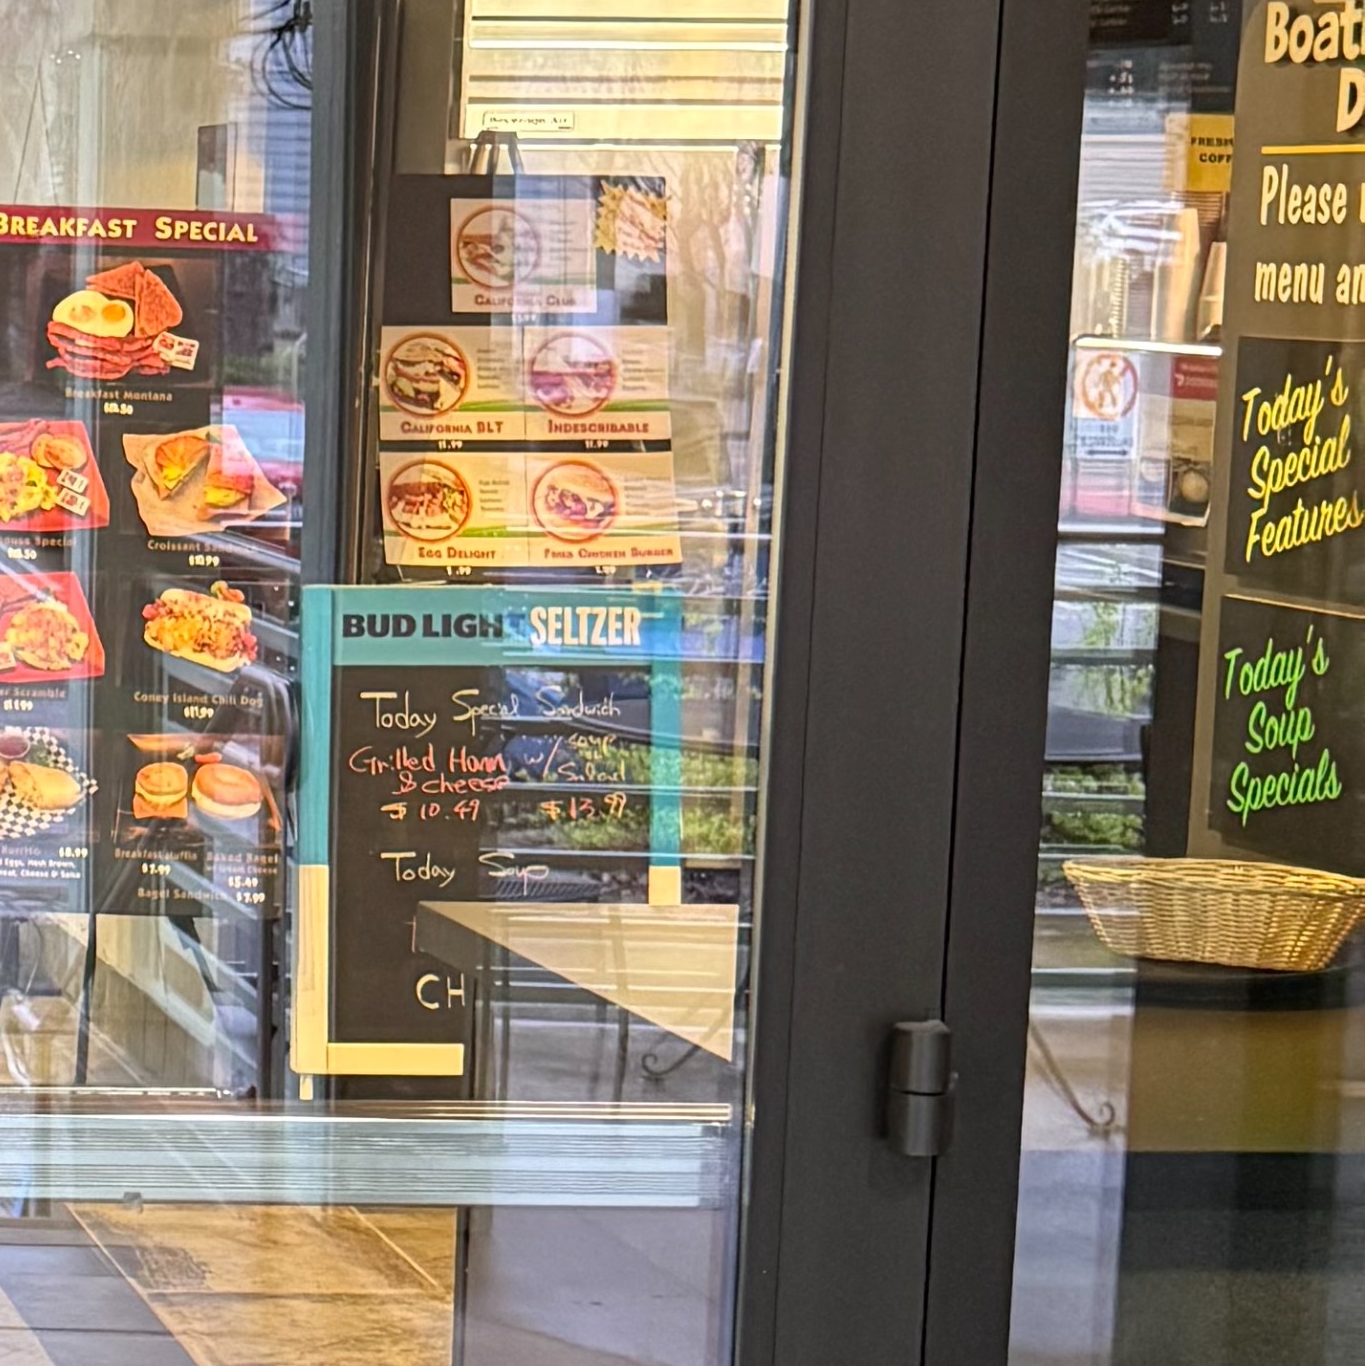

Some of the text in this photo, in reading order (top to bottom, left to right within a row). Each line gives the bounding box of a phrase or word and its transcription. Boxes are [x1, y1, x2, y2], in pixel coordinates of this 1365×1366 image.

[1337, 67, 1365, 133] D
[1199, 153, 1232, 163] COFF
[1260, 163, 1347, 225] Please
[155, 216, 258, 242] SPECIAL
[1254, 261, 1365, 305] menu an
[124, 391, 173, 402] Montana
[1242, 355, 1348, 442] Today's
[401, 421, 503, 434] CALIFORNIA BLT
[548, 420, 649, 434] INDESCRIBABLE
[1247, 416, 1350, 508] Special
[147, 540, 201, 552] Croissant
[1246, 491, 1364, 563] Features
[447, 547, 496, 560] DELIGHT
[342, 614, 416, 638] BUD
[530, 606, 641, 645] SELTZER
[1224, 626, 1330, 707] Today's
[133, 691, 169, 704] Coney
[173, 693, 208, 704] Island
[240, 695, 264, 708] Dog
[360, 685, 621, 738] Today Special Sandwich
[1245, 702, 1315, 759] Soup
[349, 742, 435, 775] Grilled
[449, 745, 507, 773] Ham
[1227, 749, 1342, 829] Specials
[380, 851, 549, 896] Today Soup
